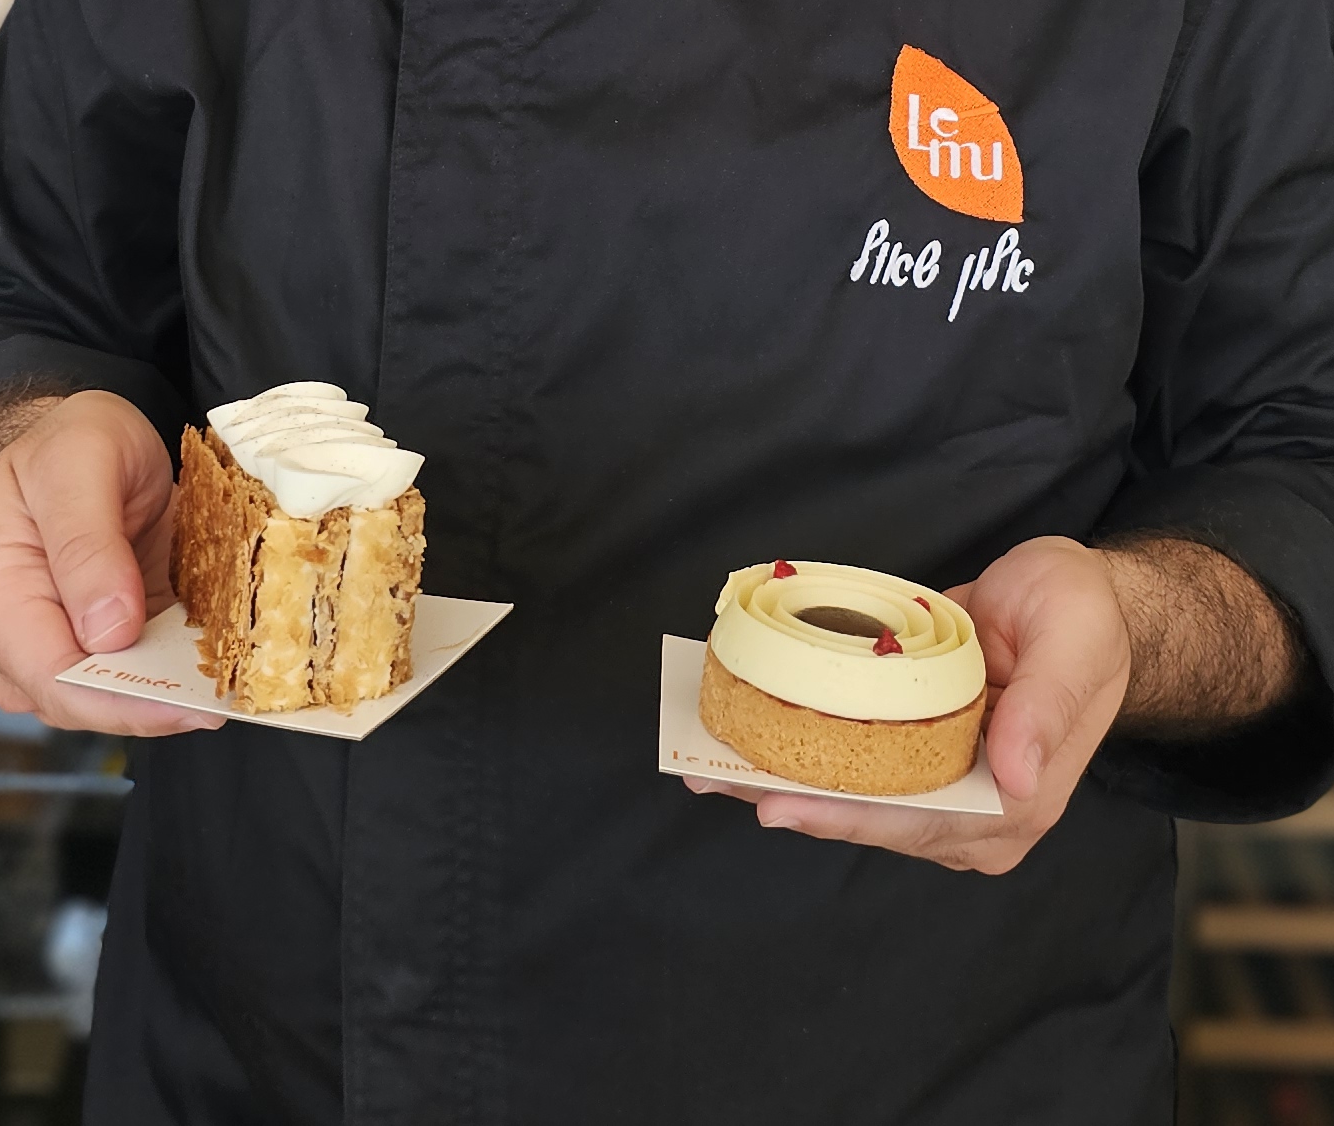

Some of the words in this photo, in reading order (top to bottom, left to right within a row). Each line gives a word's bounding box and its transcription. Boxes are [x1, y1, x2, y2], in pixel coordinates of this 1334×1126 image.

[849, 218, 942, 289] שאול
[947, 227, 1035, 323] אלון
[83, 663, 112, 676] Le
[113, 671, 182, 691] musée
[672, 750, 700, 763] Le
[709, 759, 763, 774] mus
